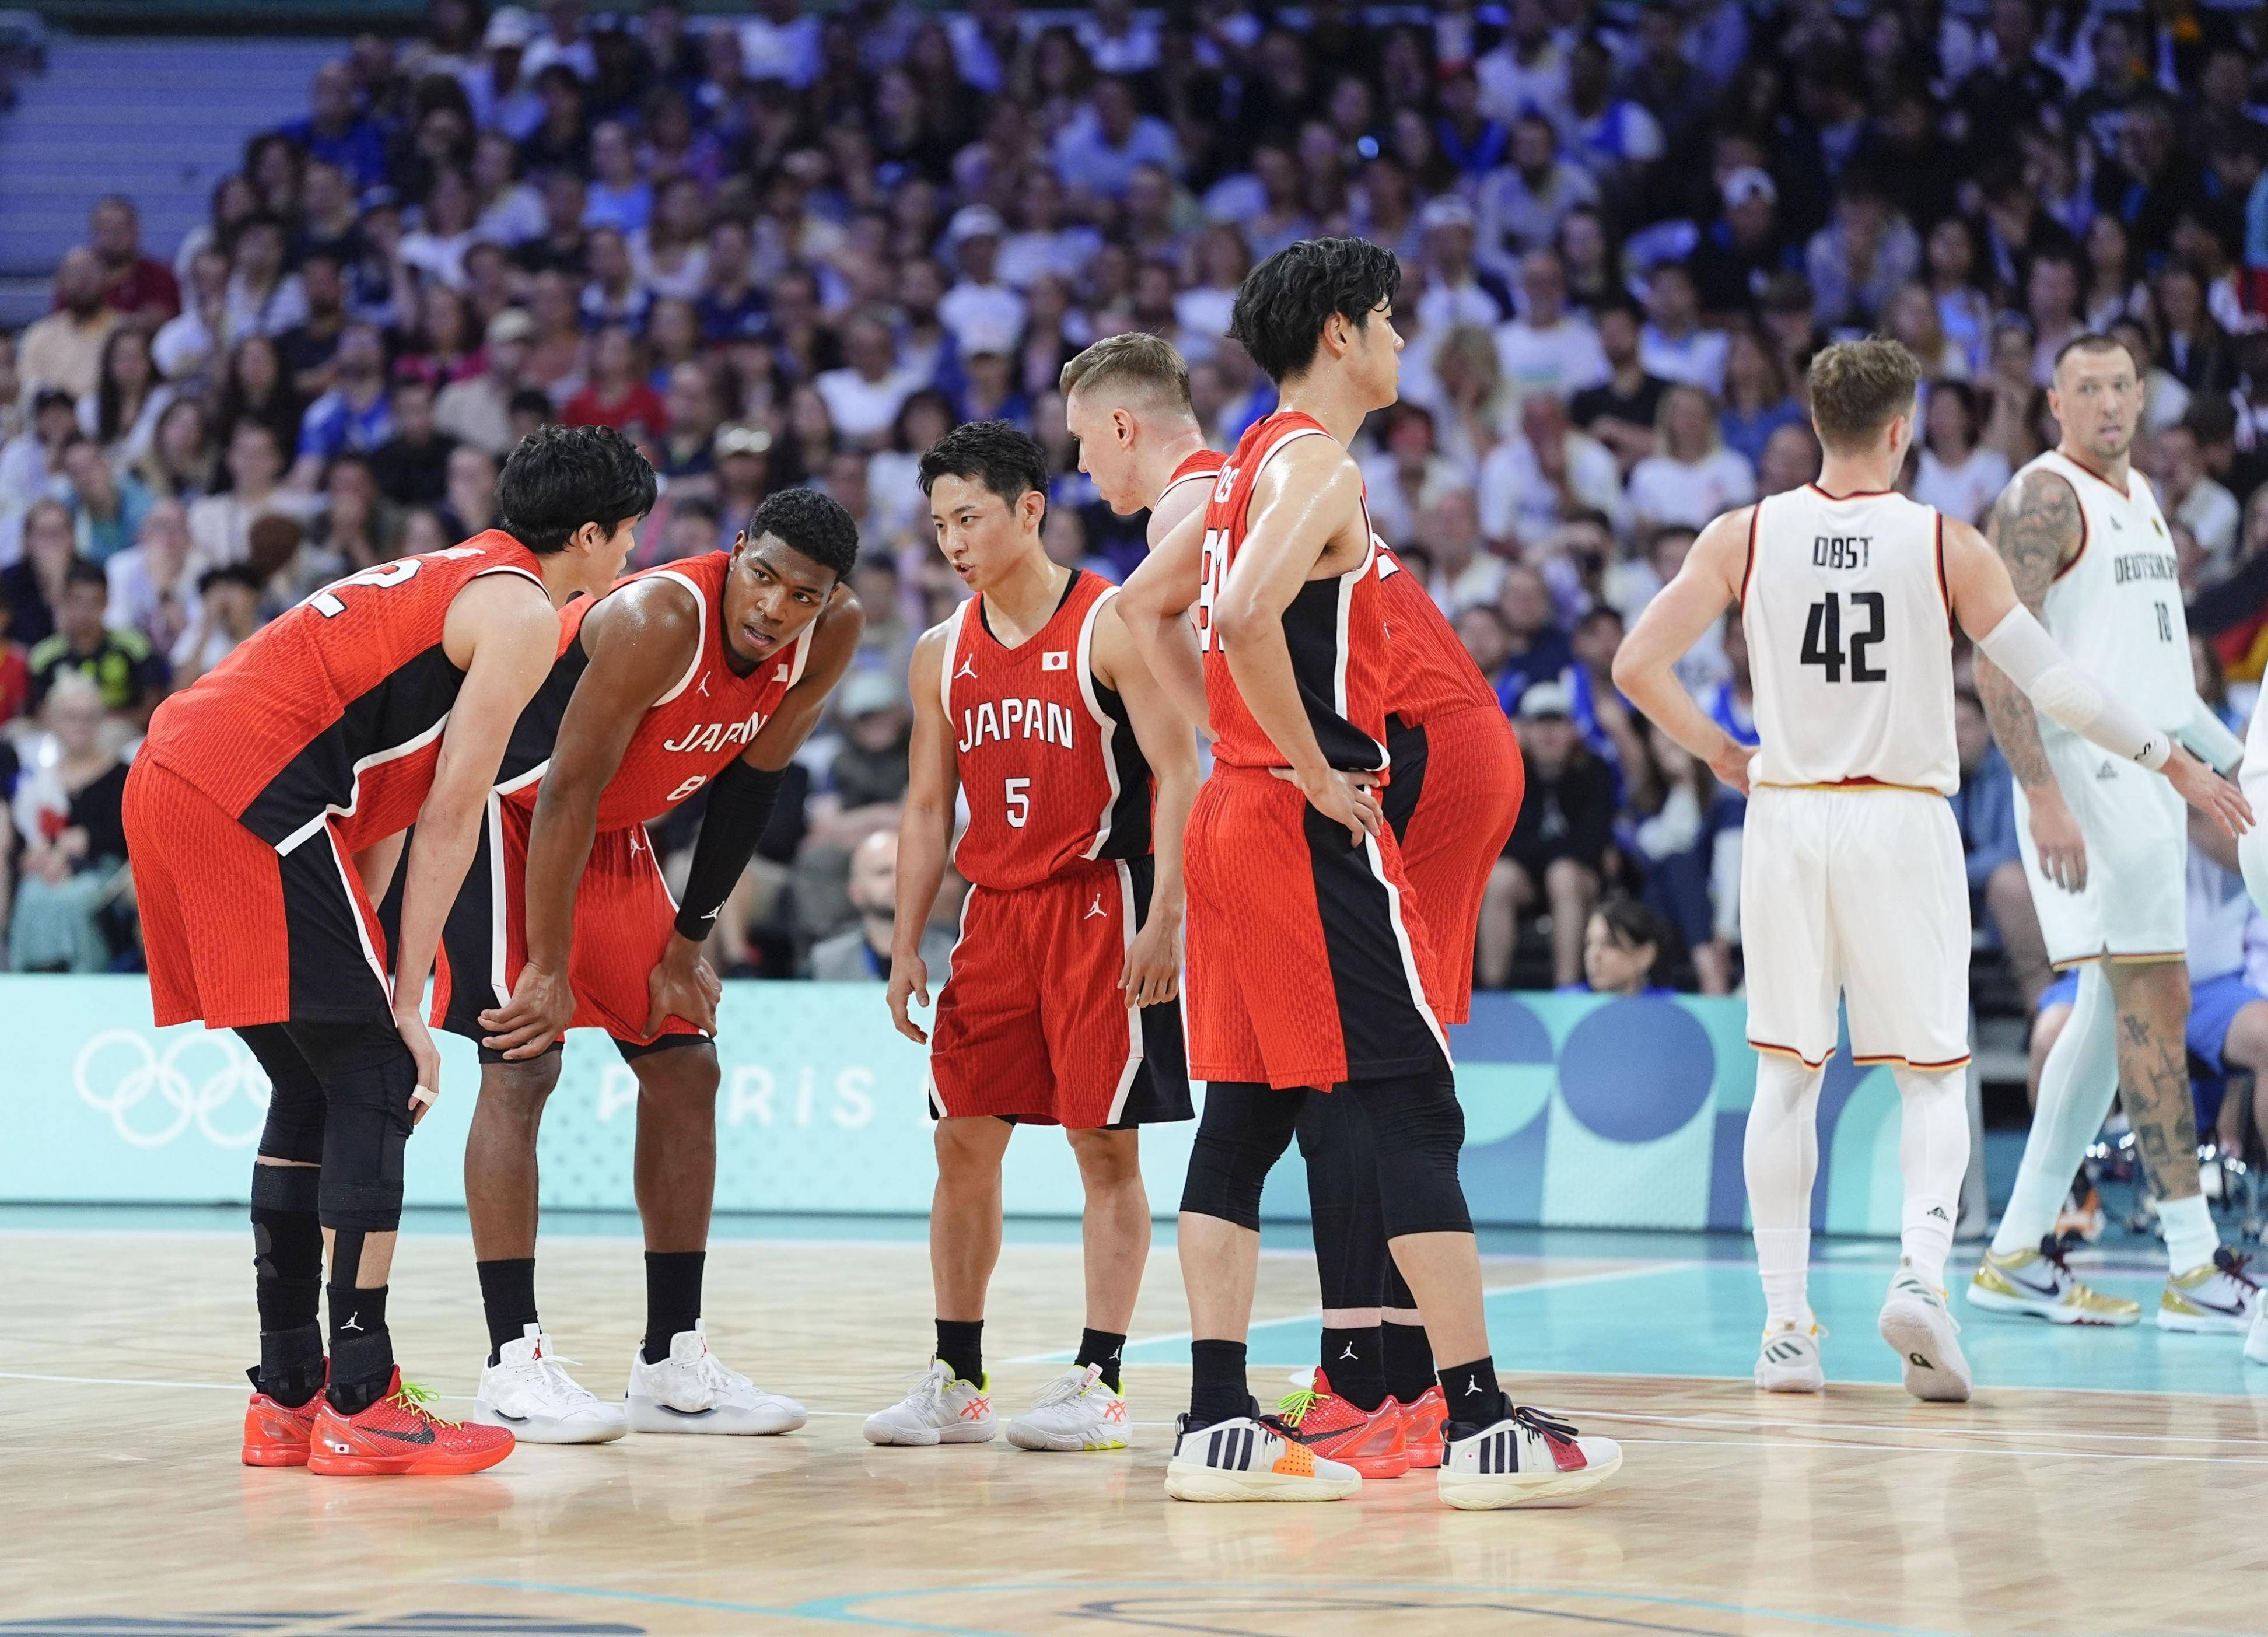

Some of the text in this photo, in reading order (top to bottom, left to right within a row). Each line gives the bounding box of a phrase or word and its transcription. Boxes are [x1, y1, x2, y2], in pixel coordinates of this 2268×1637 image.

[1812, 536, 1873, 569] OBST
[1800, 591, 1887, 683] 42
[663, 711, 768, 753] JAPN
[958, 698, 1074, 753] JAPAN
[666, 775, 707, 801] 8
[1005, 777, 1031, 828] 5
[595, 1065, 876, 1130] PRIS
